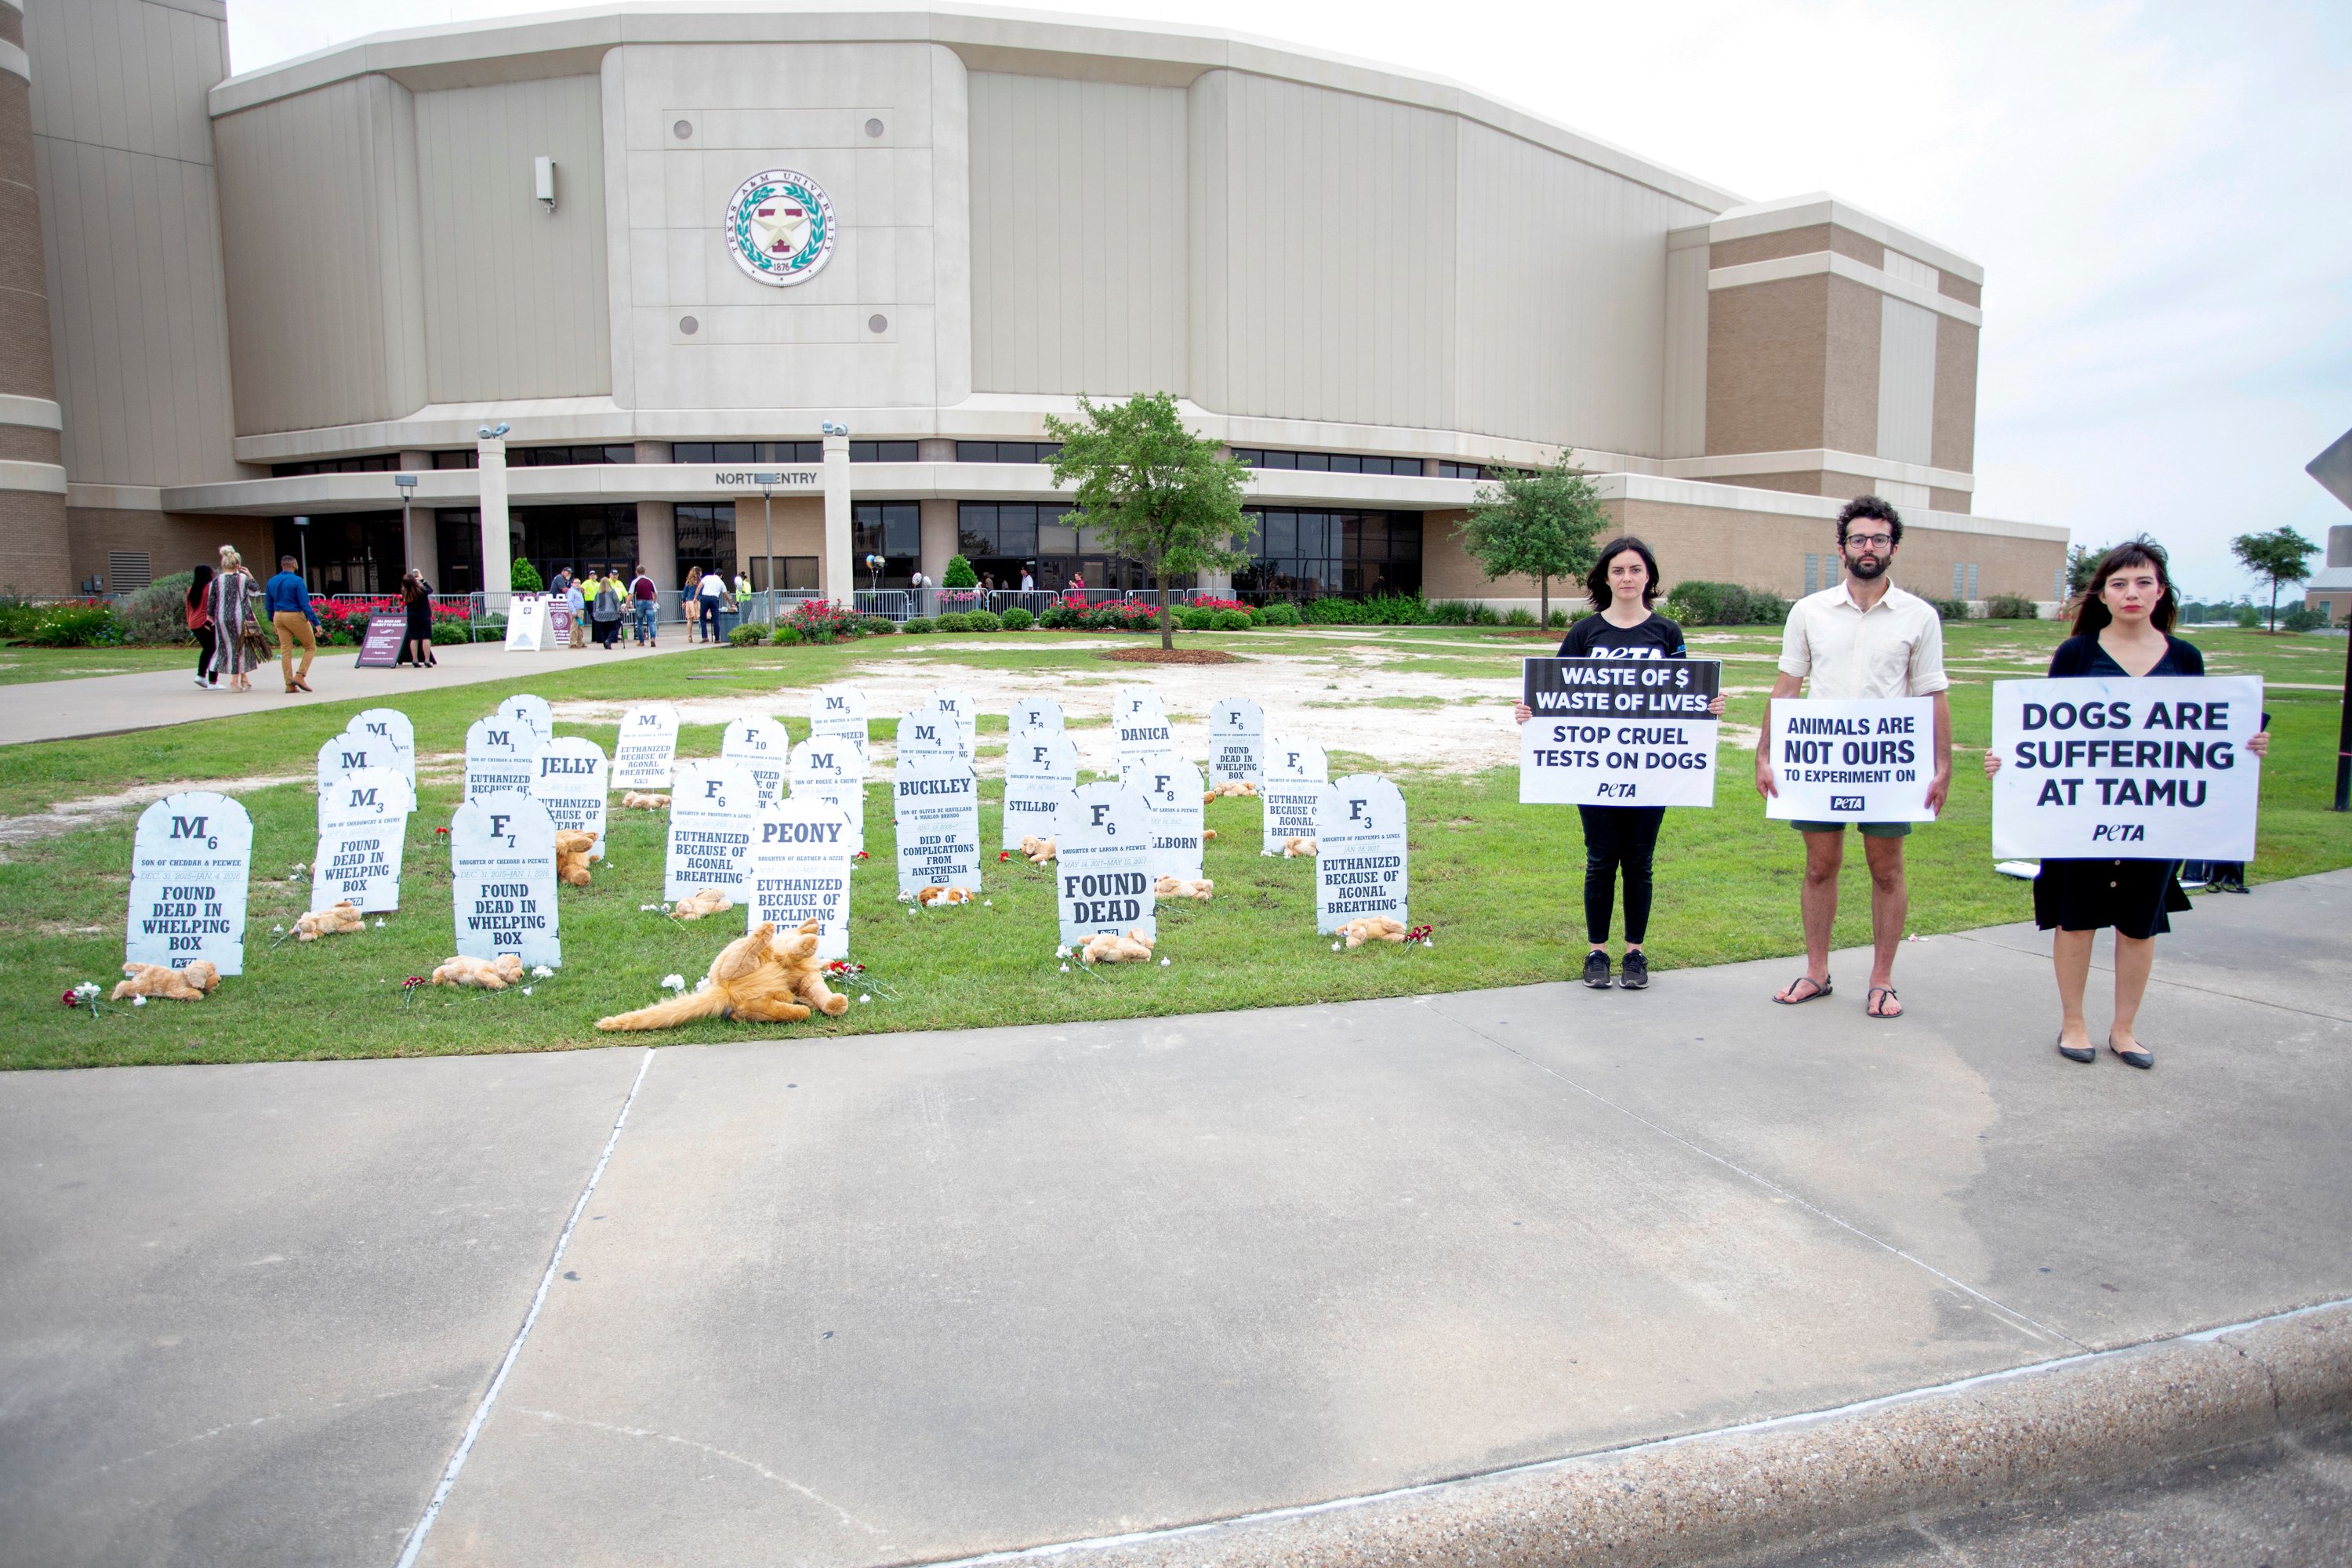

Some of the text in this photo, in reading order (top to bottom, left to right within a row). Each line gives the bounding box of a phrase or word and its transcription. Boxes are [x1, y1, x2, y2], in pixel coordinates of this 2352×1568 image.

[783, 172, 834, 252] UNIVERSITY
[1561, 667, 1689, 688] WASTE OF $
[1536, 691, 1708, 711] WASTE OF LIVES
[2022, 702, 2230, 731] DOGS ARE
[1787, 717, 1915, 735] ANIMALS ARE
[1121, 728, 1170, 741] DANICA
[1552, 725, 1689, 745] STOP CRUEL
[1784, 739, 1915, 765] NOT OURS
[2014, 740, 2234, 771] SUFFERING
[1533, 750, 1708, 770] TESTS ON DOGS
[541, 757, 597, 778] JELLY
[470, 775, 531, 783] EUTHANIZED
[1784, 769, 1915, 783] TO EXPERIMENT ON
[766, 781, 778, 789] OF
[899, 779, 971, 796] BUCKLEY
[2036, 779, 2207, 808] AT TAMU
[1279, 817, 1313, 826] AGONAL
[675, 831, 750, 844] EUTHANIZED
[762, 823, 842, 843] PEONY
[1272, 828, 1316, 837] BREATHIN
[340, 839, 379, 853] FOUND
[920, 836, 941, 844] DIED
[676, 844, 747, 857] BECAUSE OF
[903, 844, 974, 855] COMPLICATIONS
[333, 851, 384, 866] DEAD IN
[687, 858, 733, 869] AGONAL
[927, 856, 952, 865] FROM
[1323, 856, 1400, 871] EUTHANIZED
[325, 865, 389, 880] WHELPING
[676, 871, 743, 884] BREATHING
[913, 865, 967, 876] ANESTHESIA
[1325, 870, 1399, 885] BECAUSE OF
[343, 880, 368, 892] BOX
[481, 884, 528, 898] FOUND
[757, 879, 843, 891] EUTHANIZED
[1065, 873, 1146, 898] FOUND
[1338, 885, 1386, 898] AGONAL
[162, 887, 216, 900] FOUND
[759, 894, 840, 906] BECAUSE OF
[153, 903, 222, 917] DEAD IN
[476, 900, 536, 913] DEAD IN
[1073, 899, 1140, 924] DEAD
[1328, 899, 1396, 913] BREATHING
[763, 909, 835, 921] DECLINING
[142, 920, 230, 934] WHELPING
[468, 916, 546, 930] WHELPING
[169, 937, 202, 950] BOX
[494, 932, 523, 945] BOX
